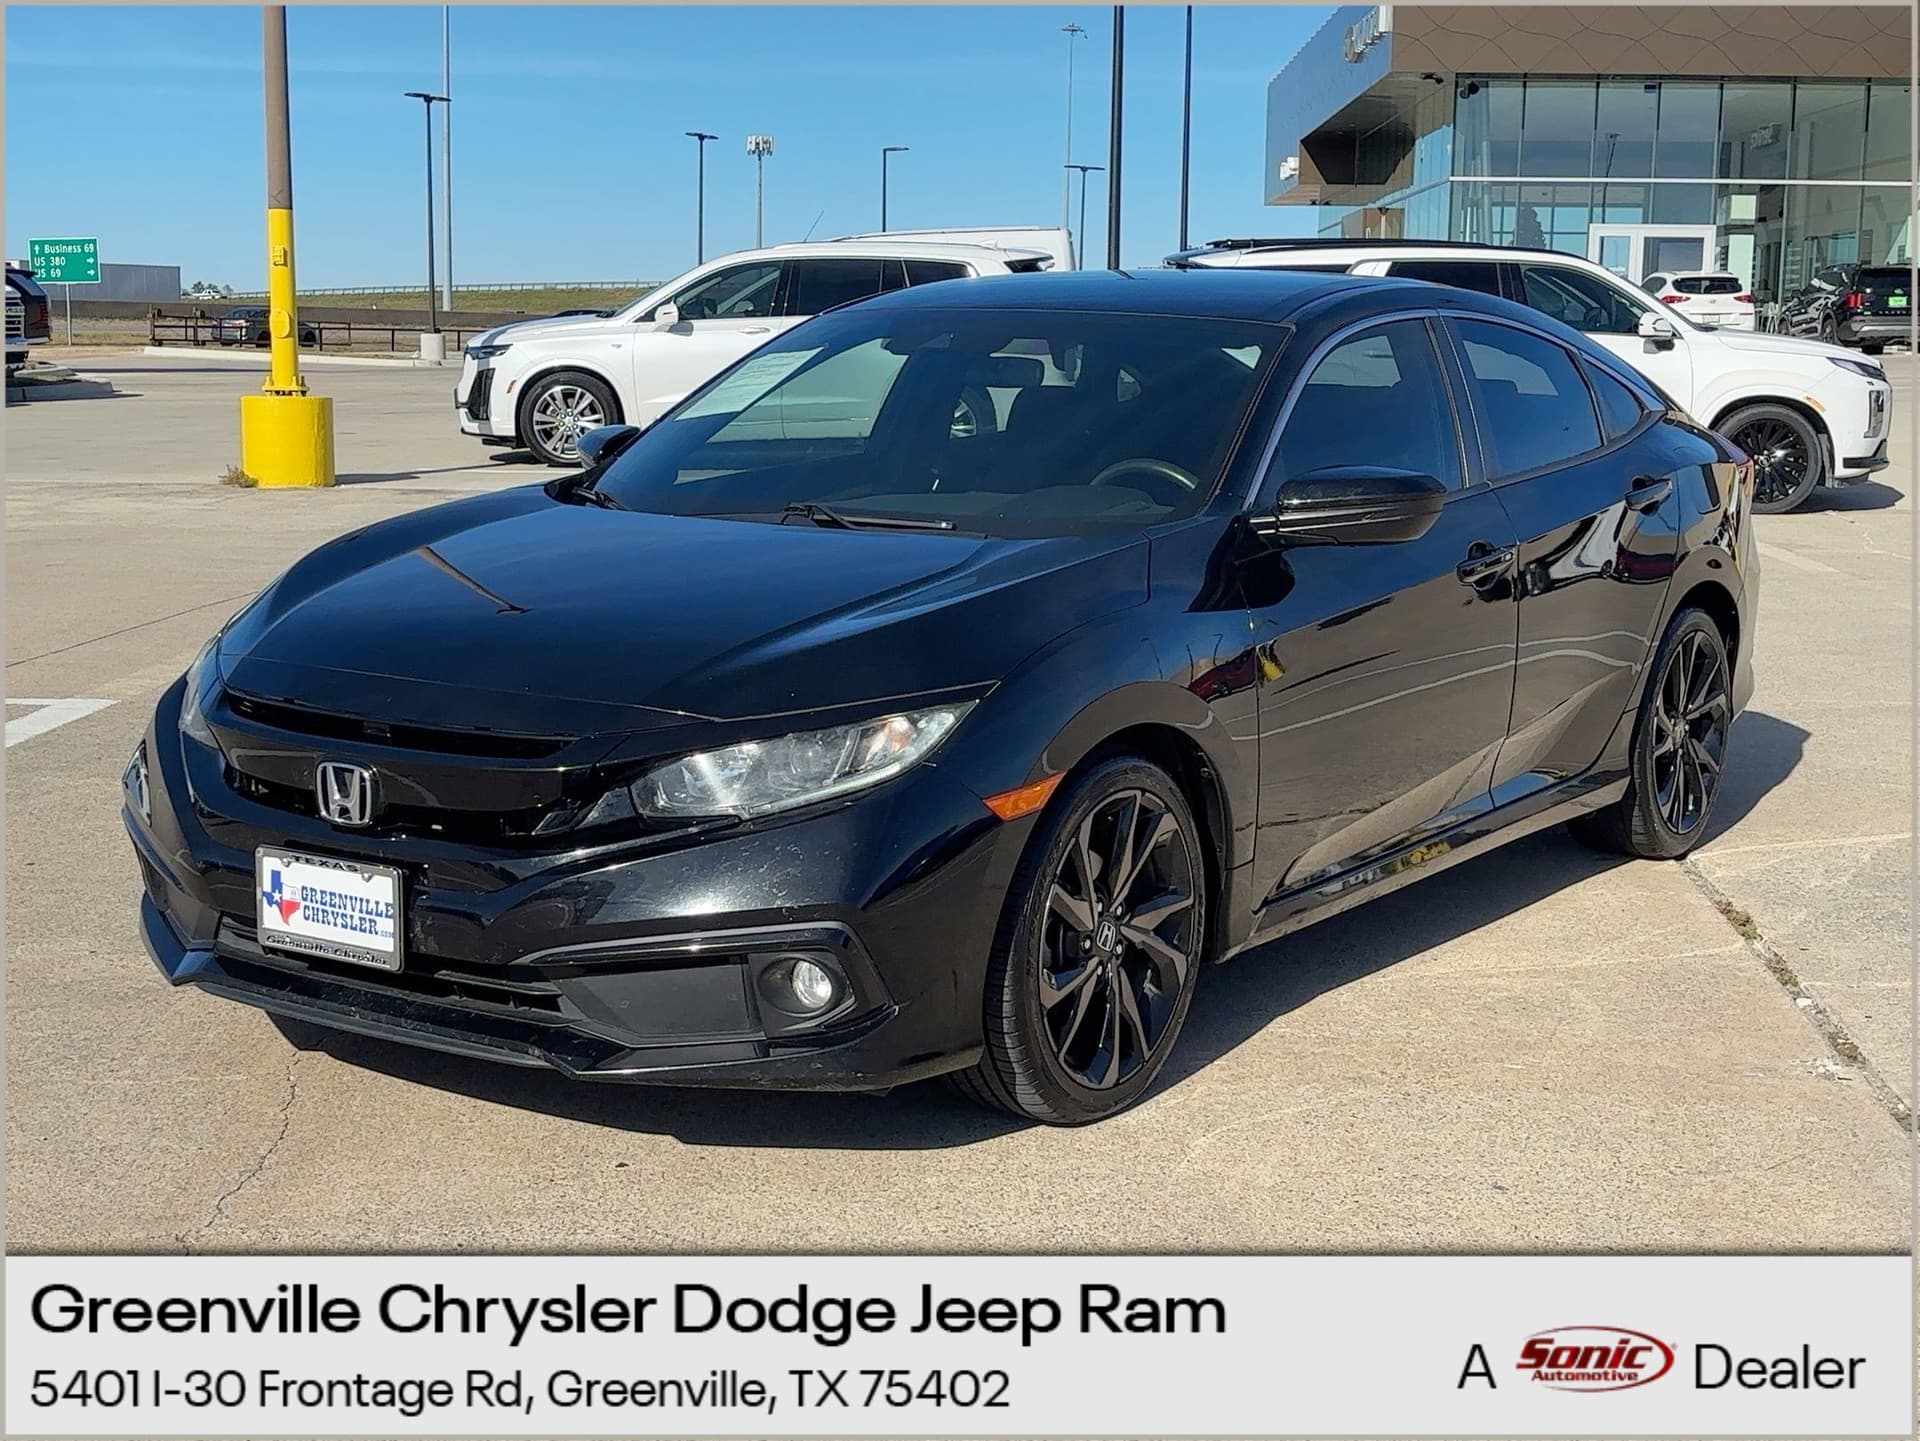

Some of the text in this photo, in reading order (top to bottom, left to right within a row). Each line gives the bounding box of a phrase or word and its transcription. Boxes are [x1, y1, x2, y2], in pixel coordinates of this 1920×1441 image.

[44, 243, 94, 254] Business 69
[34, 256, 66, 266] US 380
[50, 268, 61, 278] 69
[291, 855, 360, 873] TEXAS
[301, 885, 394, 919] GREENVILLE
[303, 904, 378, 936] CHRYSLER
